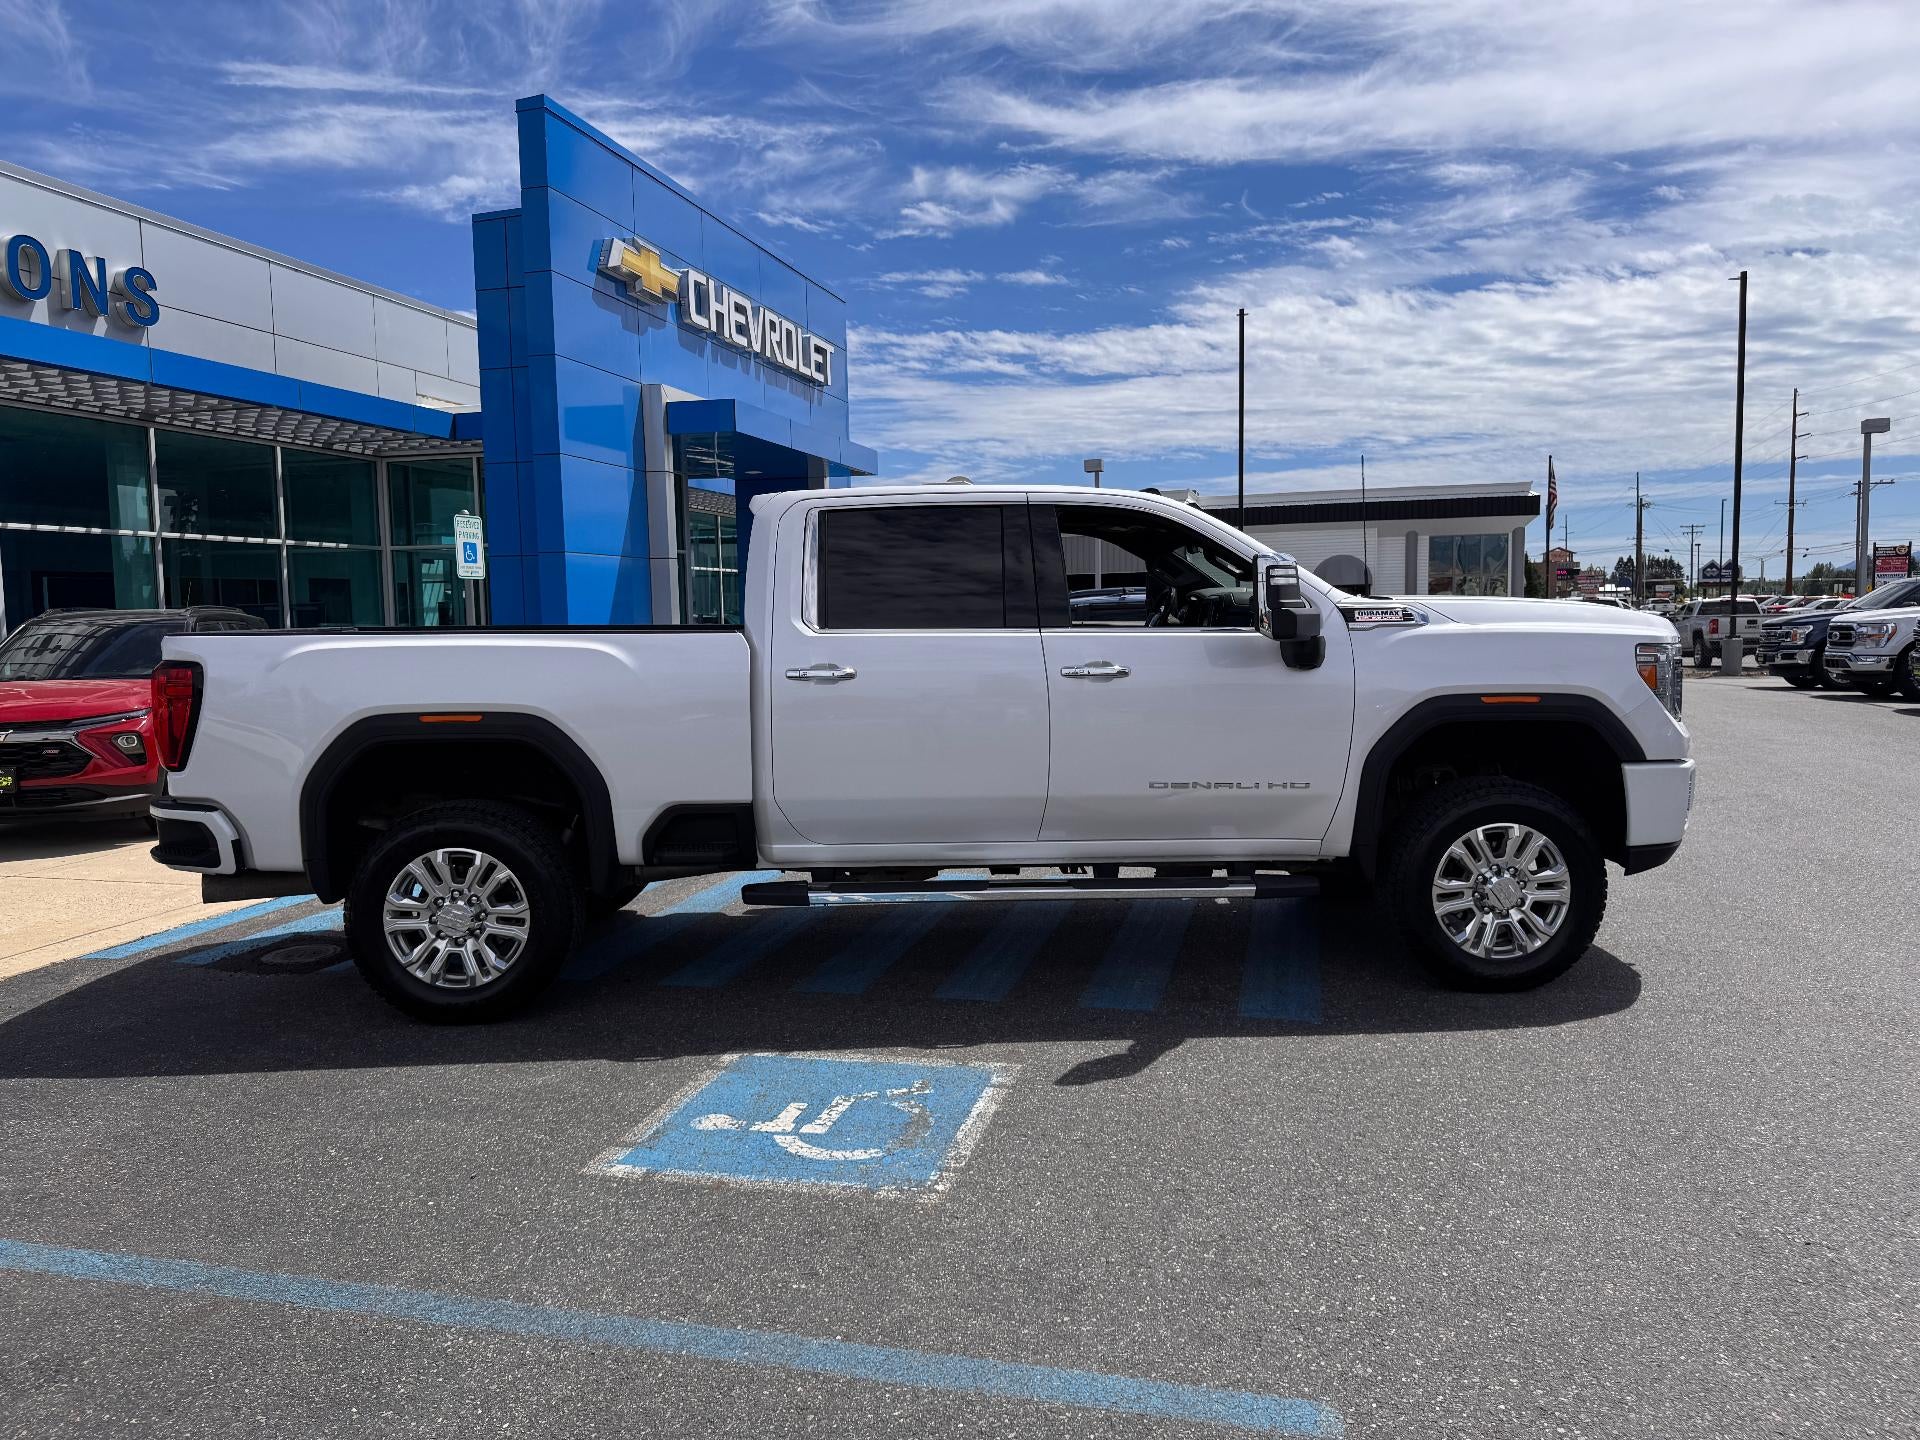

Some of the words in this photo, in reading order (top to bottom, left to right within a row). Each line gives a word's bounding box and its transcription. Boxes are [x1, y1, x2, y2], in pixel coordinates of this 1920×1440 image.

[686, 267, 835, 386] CHEVROLET
[456, 519, 480, 530] RESERVED
[458, 530, 480, 541] PARKING
